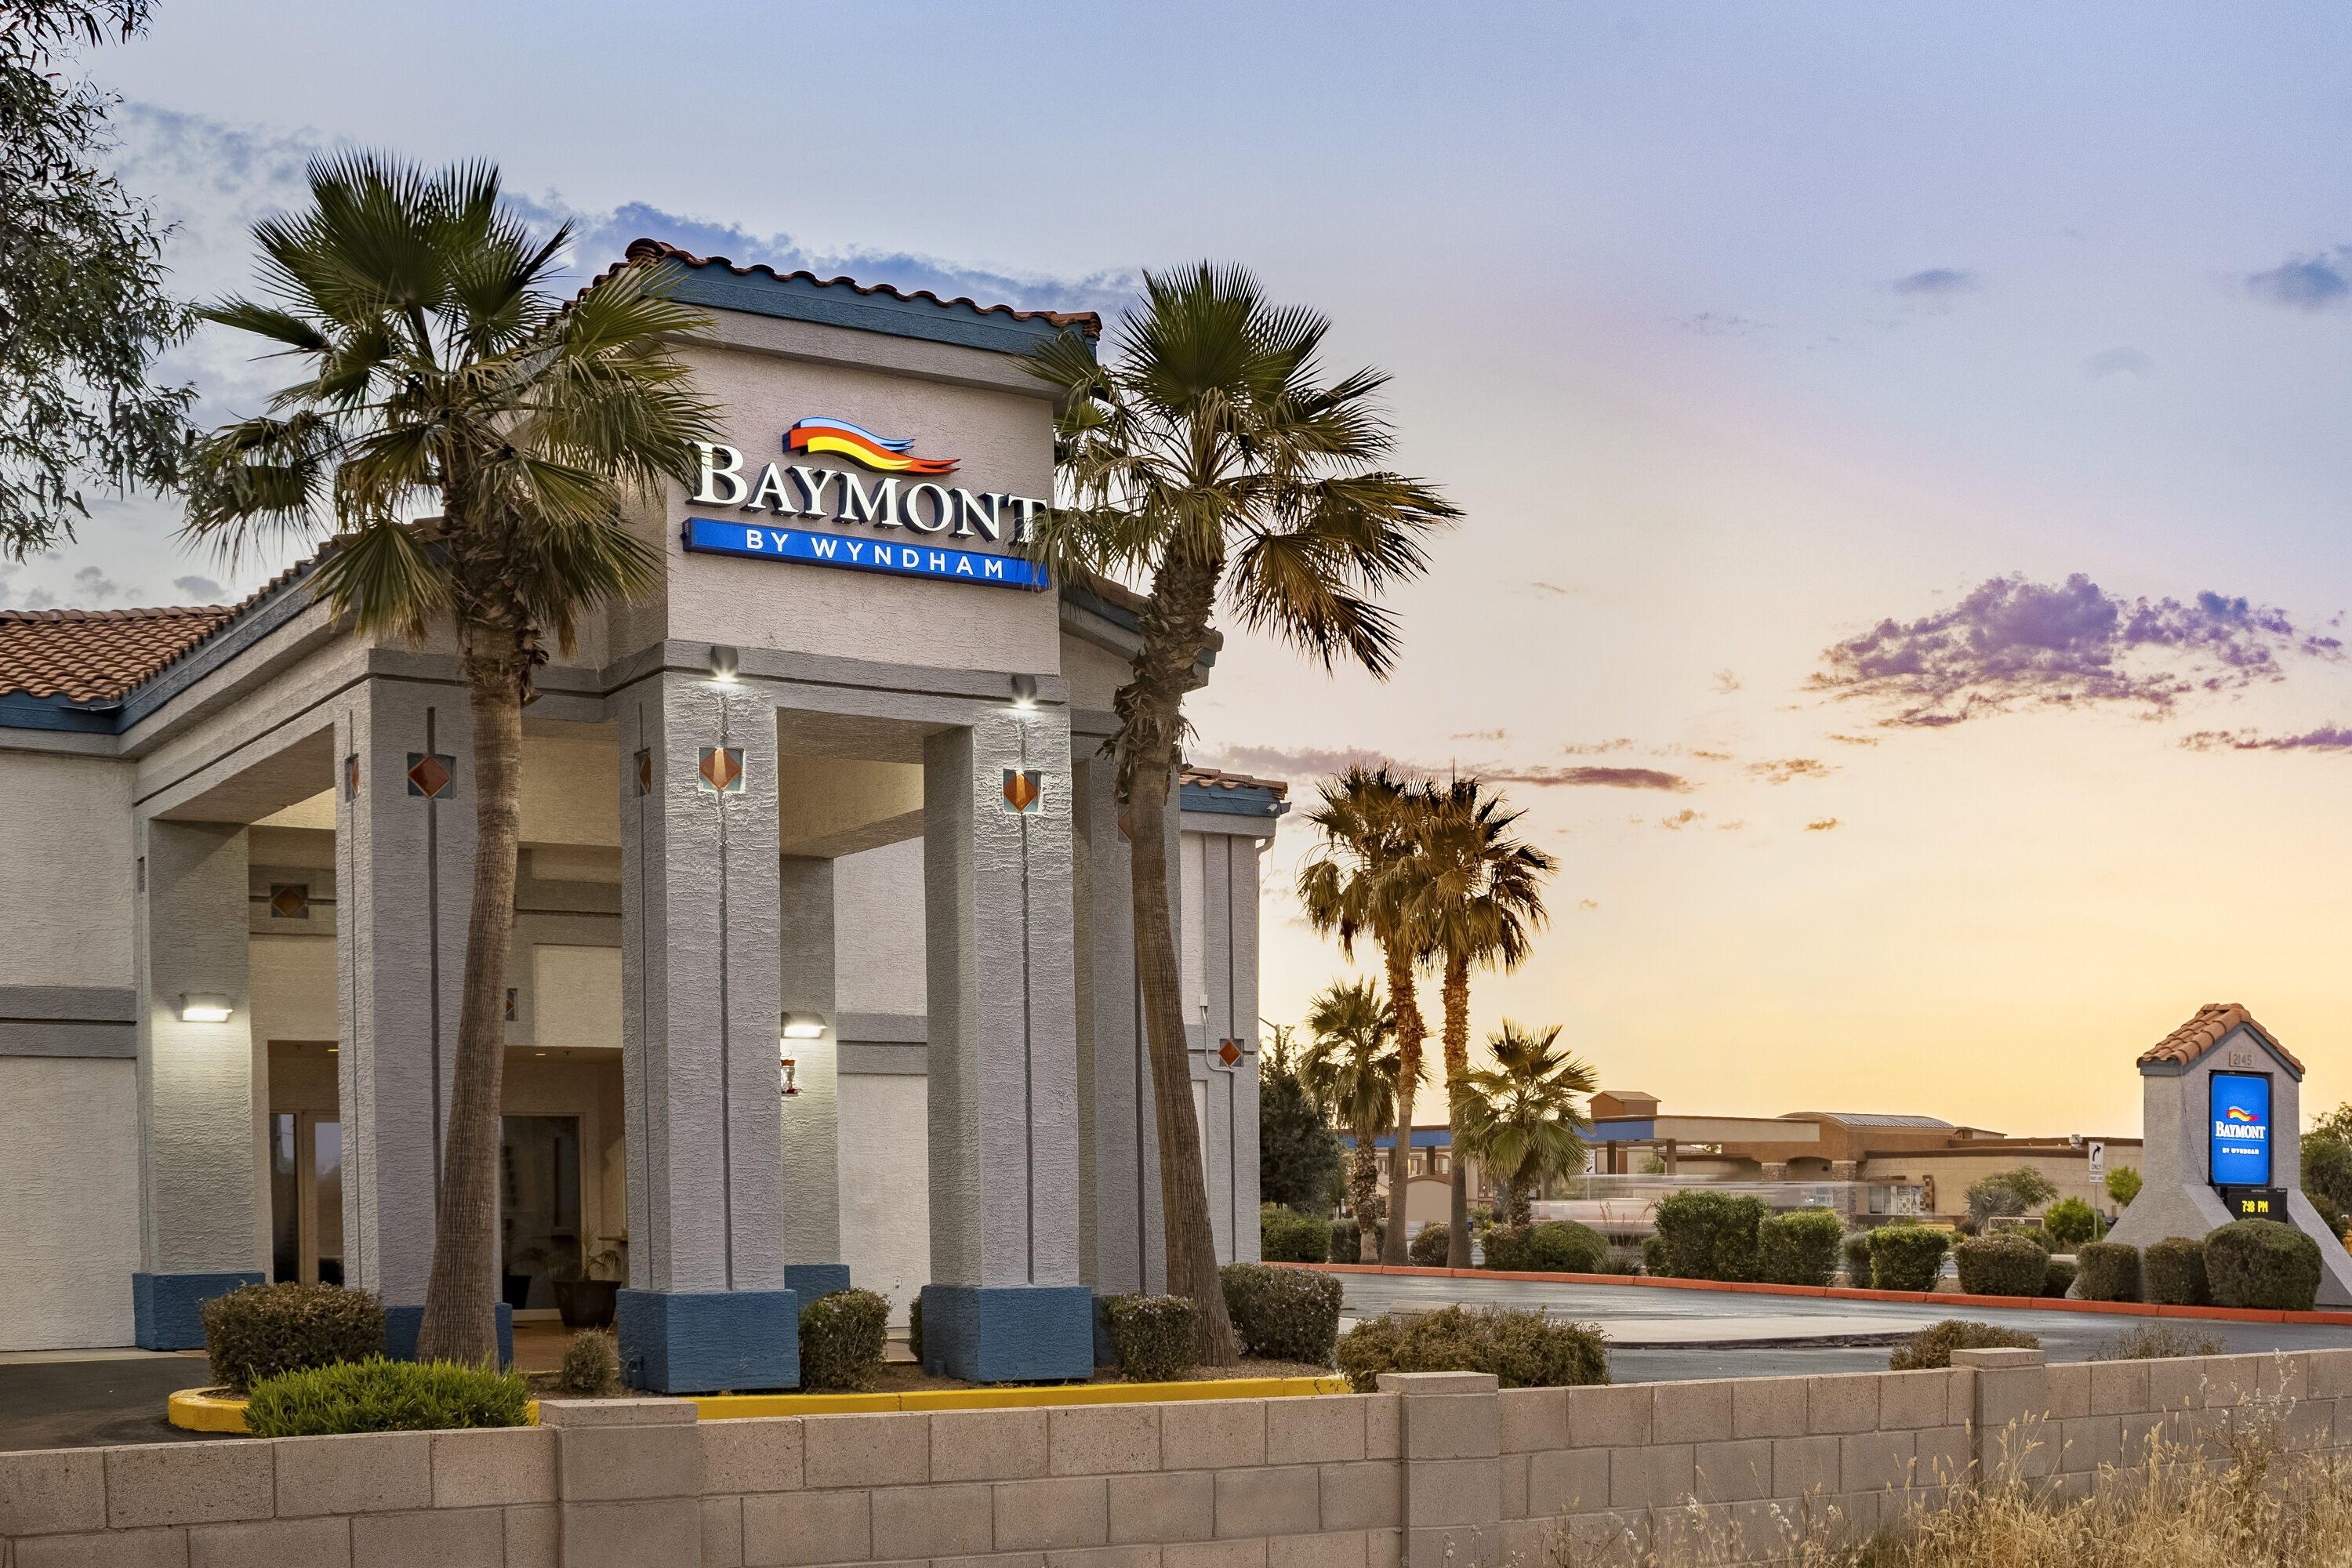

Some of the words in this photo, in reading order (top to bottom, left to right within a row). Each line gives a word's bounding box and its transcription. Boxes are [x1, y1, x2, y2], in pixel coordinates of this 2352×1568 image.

[691, 440, 1049, 544] BAYMONT
[746, 529, 789, 553] BY
[811, 537, 1003, 579] WYNDHAM
[2234, 1053, 2252, 1066] 2145
[2215, 1120, 2266, 1139] BAYMONT
[2258, 1200, 2268, 1213] PM
